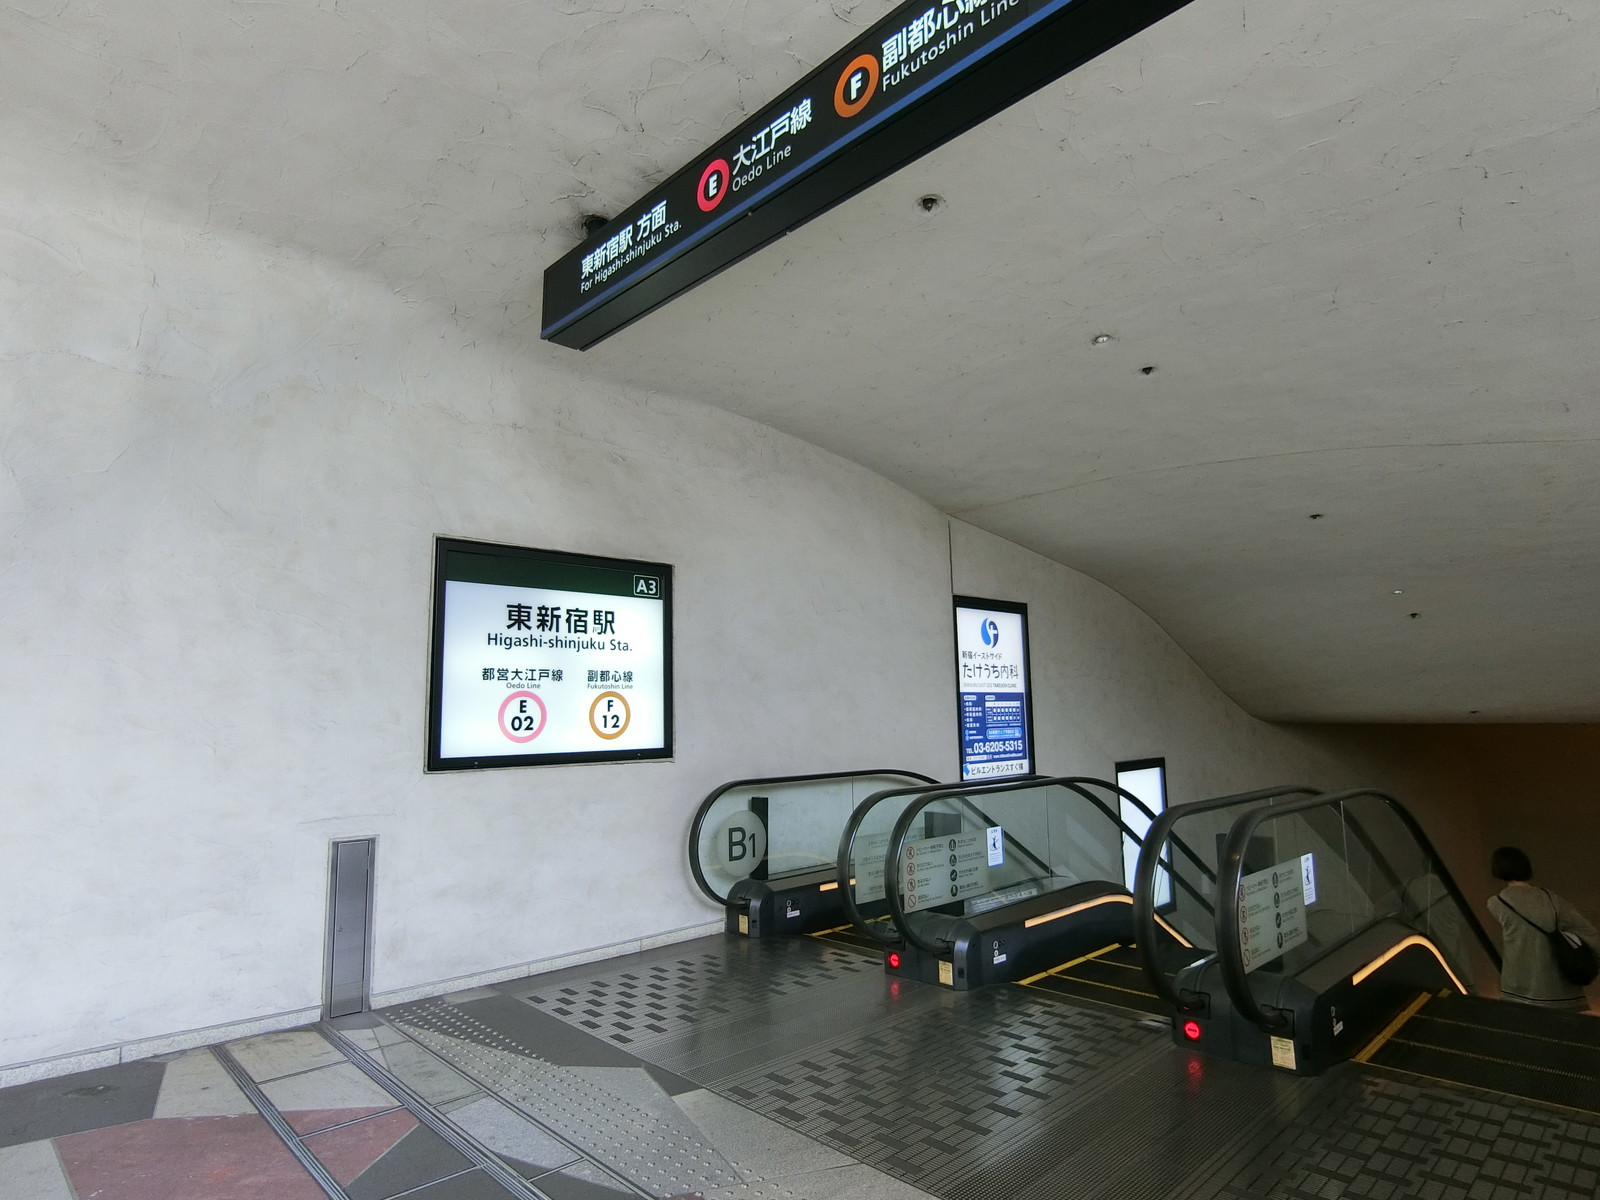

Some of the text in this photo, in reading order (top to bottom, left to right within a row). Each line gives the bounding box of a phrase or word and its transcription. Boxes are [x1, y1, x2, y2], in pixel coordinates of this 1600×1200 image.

[882, 23, 974, 92] Fukutoshin
[850, 72, 862, 100] F
[732, 98, 812, 175] 大江戸線
[732, 145, 792, 192] Oedo Line
[708, 174, 718, 197] E
[581, 200, 667, 279] 東新宿駅 方面
[581, 221, 682, 294] For Higashi-shinjuku Sta.
[636, 579, 657, 594] A3
[506, 603, 615, 635] 東新宿駅
[487, 633, 633, 652] Higashi-shinjuku Sta.
[482, 667, 564, 682] 都営大江戸線
[587, 670, 633, 683] 副都心線
[962, 662, 1018, 679] たけうち内科
[519, 700, 527, 713] E
[607, 700, 614, 712] F
[511, 716, 534, 731] 02
[602, 714, 620, 728] 12
[973, 740, 1023, 754] 03-6205-5315
[728, 826, 756, 862] B1
